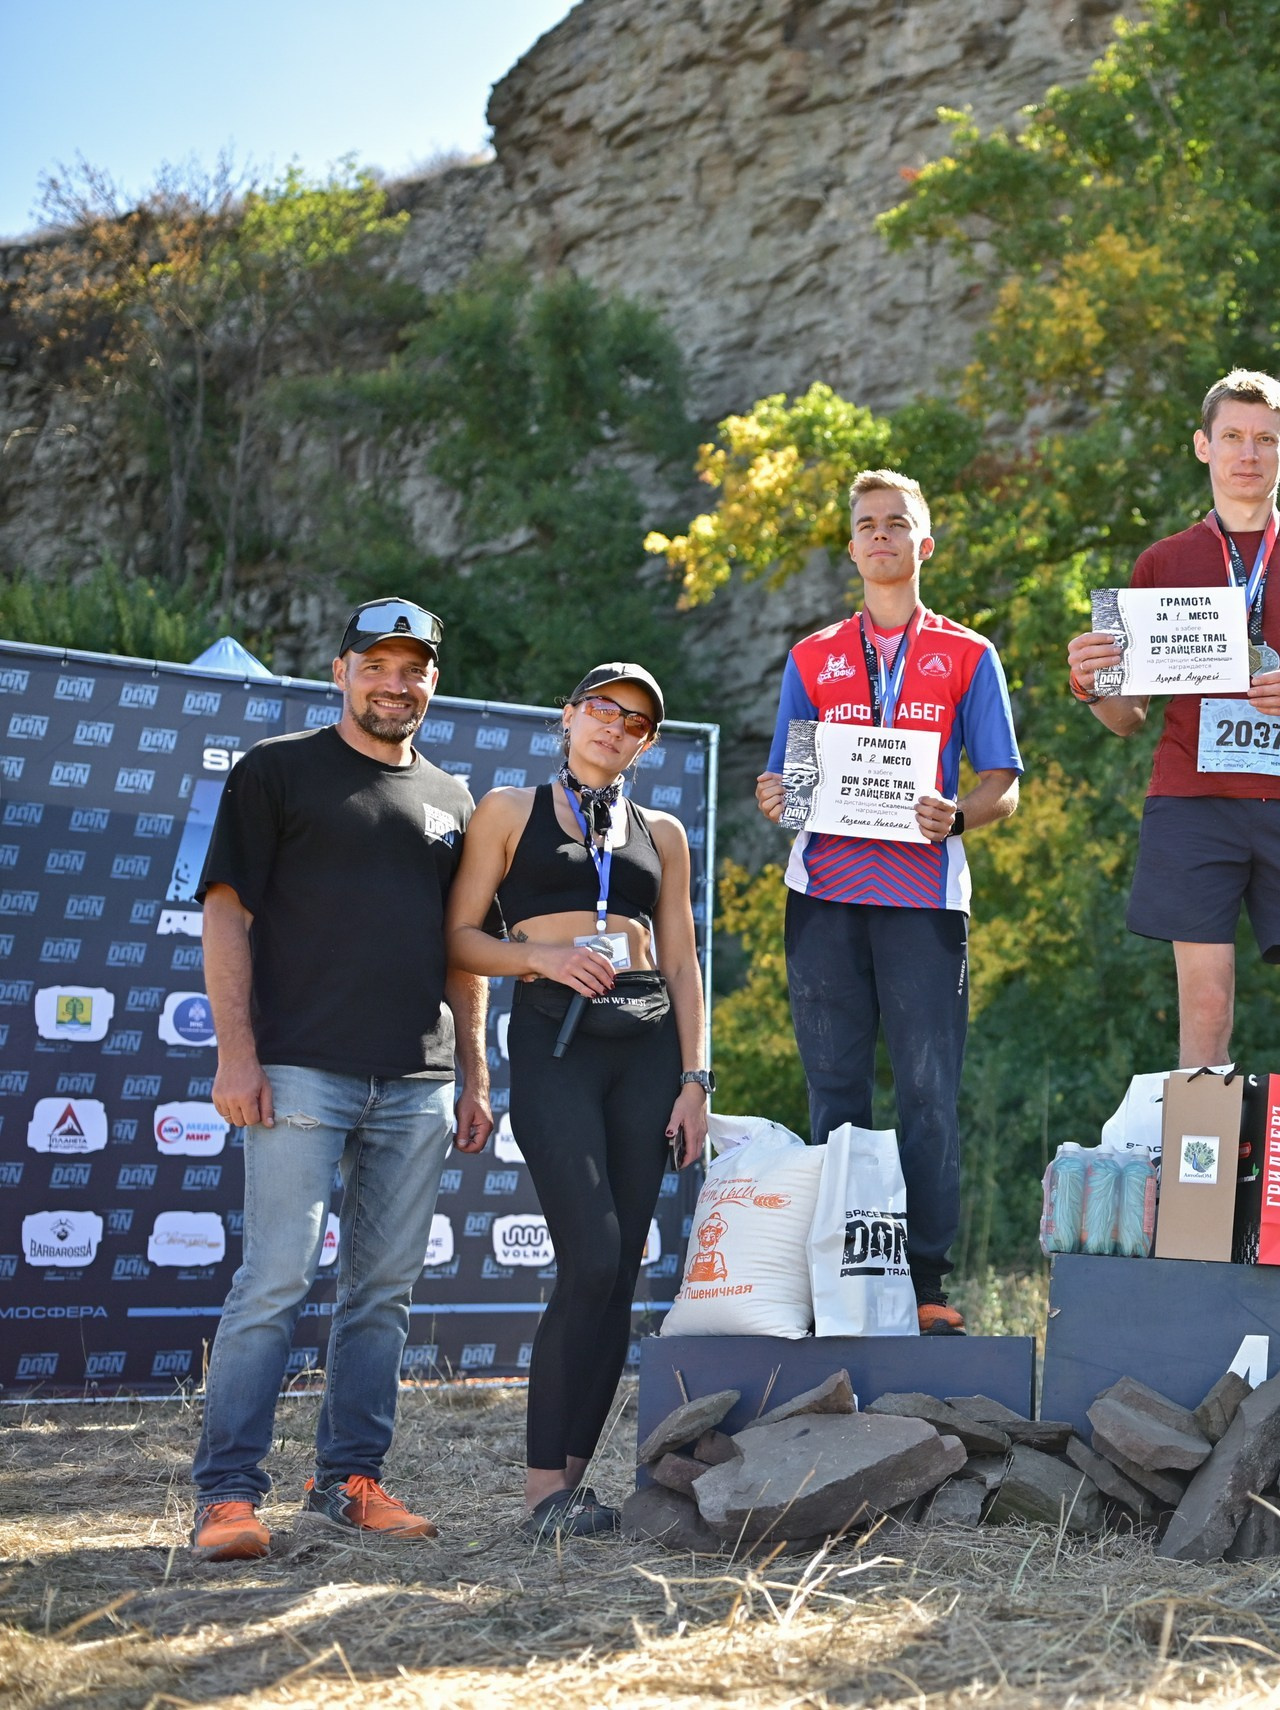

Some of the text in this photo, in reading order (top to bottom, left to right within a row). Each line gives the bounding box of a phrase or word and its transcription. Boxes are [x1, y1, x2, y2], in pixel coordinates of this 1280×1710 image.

[1160, 597, 1211, 607] ГРАМОТА
[1156, 613, 1168, 621] ЗА
[1188, 612, 1219, 620] МЕСТО
[1150, 634, 1227, 644] DON SPACE TRAIL
[1164, 644, 1213, 655] ЗАЙЦЕВКА
[1185, 671, 1220, 685] Андрей
[824, 701, 946, 723] #ЮФАБЕГ
[857, 737, 906, 750] ГРАМОТА
[851, 753, 911, 766] ЗА 2 МЕСТО
[841, 775, 915, 790] DON SPACE TRAIL
[854, 787, 901, 800] ЗАЙЦЕВКА
[843, 800, 878, 808] дистанции
[855, 808, 897, 816] награждается
[873, 818, 911, 829] Николай
[131, 904, 156, 919] DO
[958, 959, 966, 986] TERREX
[626, 998, 646, 1007] TRUST
[185, 1133, 211, 1141] МИР
[845, 1209, 880, 1219] SPACE
[30, 1237, 92, 1257] BARBAROSSA
[502, 1250, 549, 1258] VOLNA
[886, 1268, 910, 1276] TRAI
[684, 1284, 753, 1300] Пшеничная
